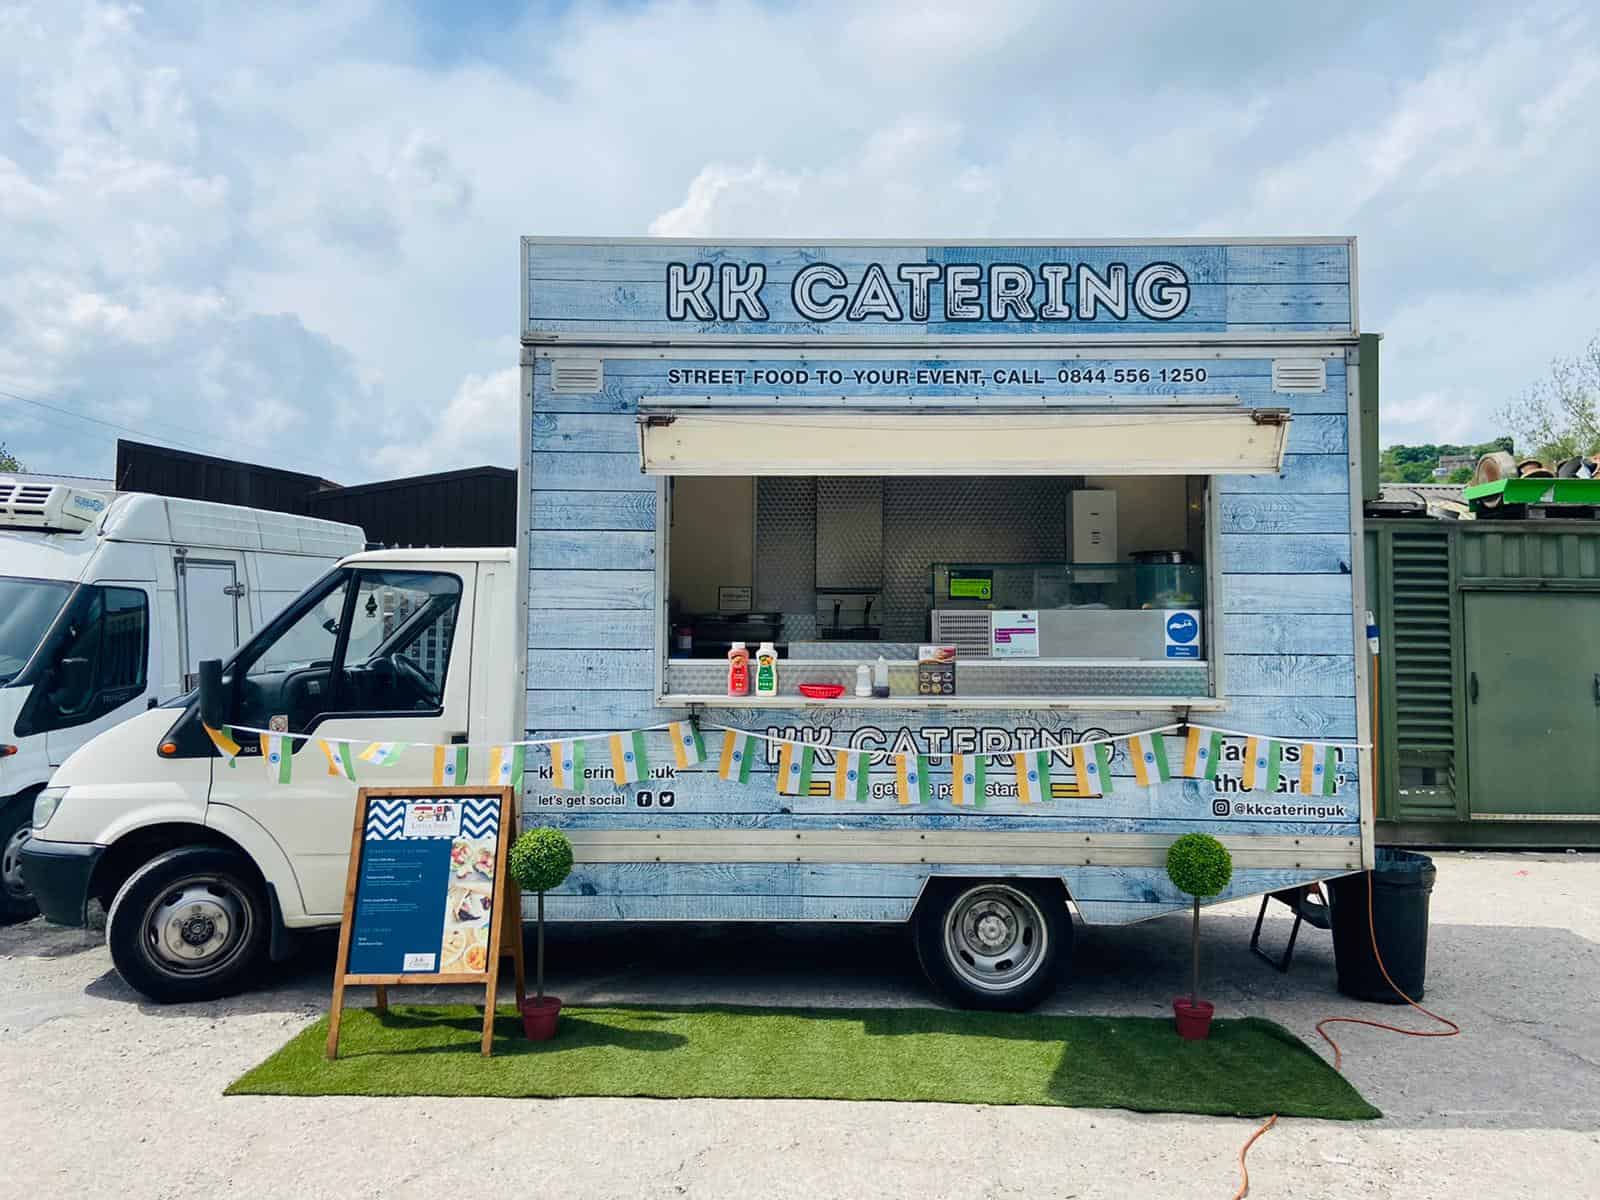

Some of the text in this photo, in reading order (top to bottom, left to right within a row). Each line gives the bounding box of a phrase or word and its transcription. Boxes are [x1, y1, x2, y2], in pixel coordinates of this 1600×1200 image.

[666, 261, 1190, 321] KK CATERING
[668, 368, 1207, 387] STREET FOOD TO YOUR EVENT, CALL 0844 556 1250
[538, 795, 625, 808] let's get social
[1234, 803, 1345, 818] @kkcateringuk
